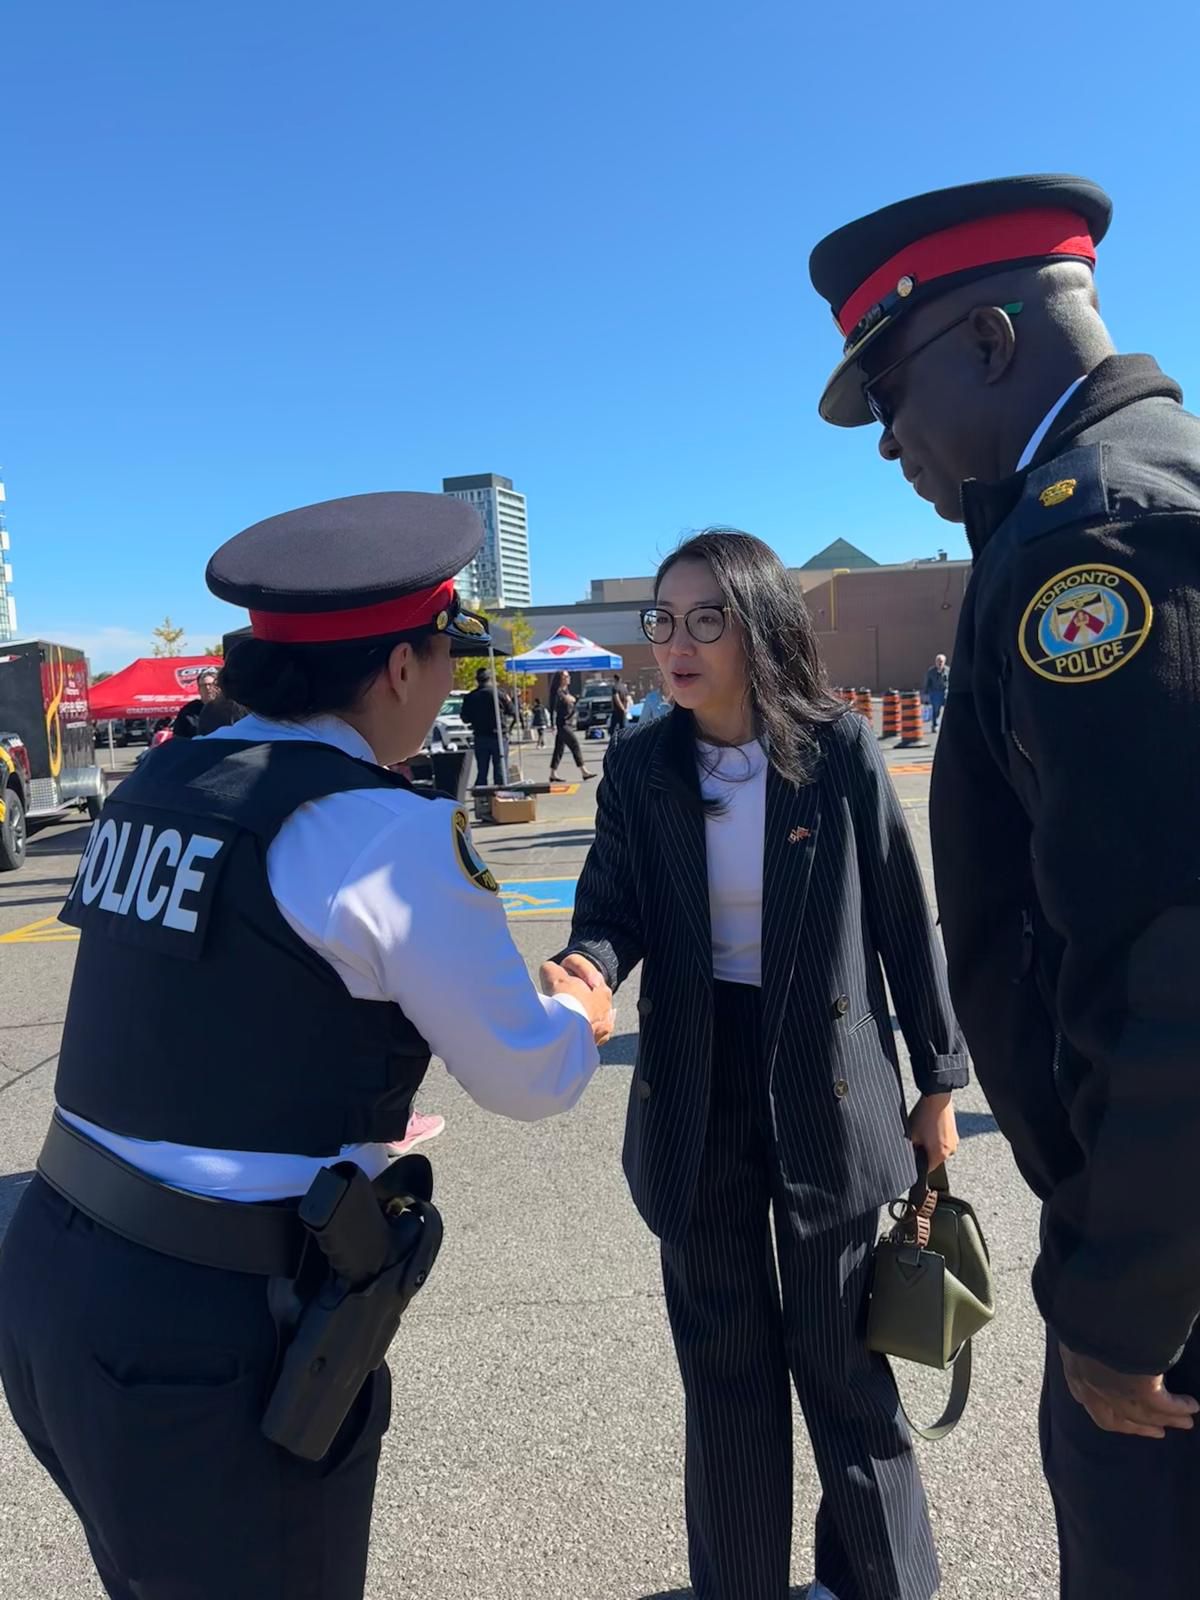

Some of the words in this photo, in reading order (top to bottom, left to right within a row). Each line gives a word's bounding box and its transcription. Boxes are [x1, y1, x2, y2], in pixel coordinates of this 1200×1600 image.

[1034, 571, 1120, 612] TORONTO
[1055, 641, 1125, 674] POLICE
[68, 818, 224, 933] POLICE
